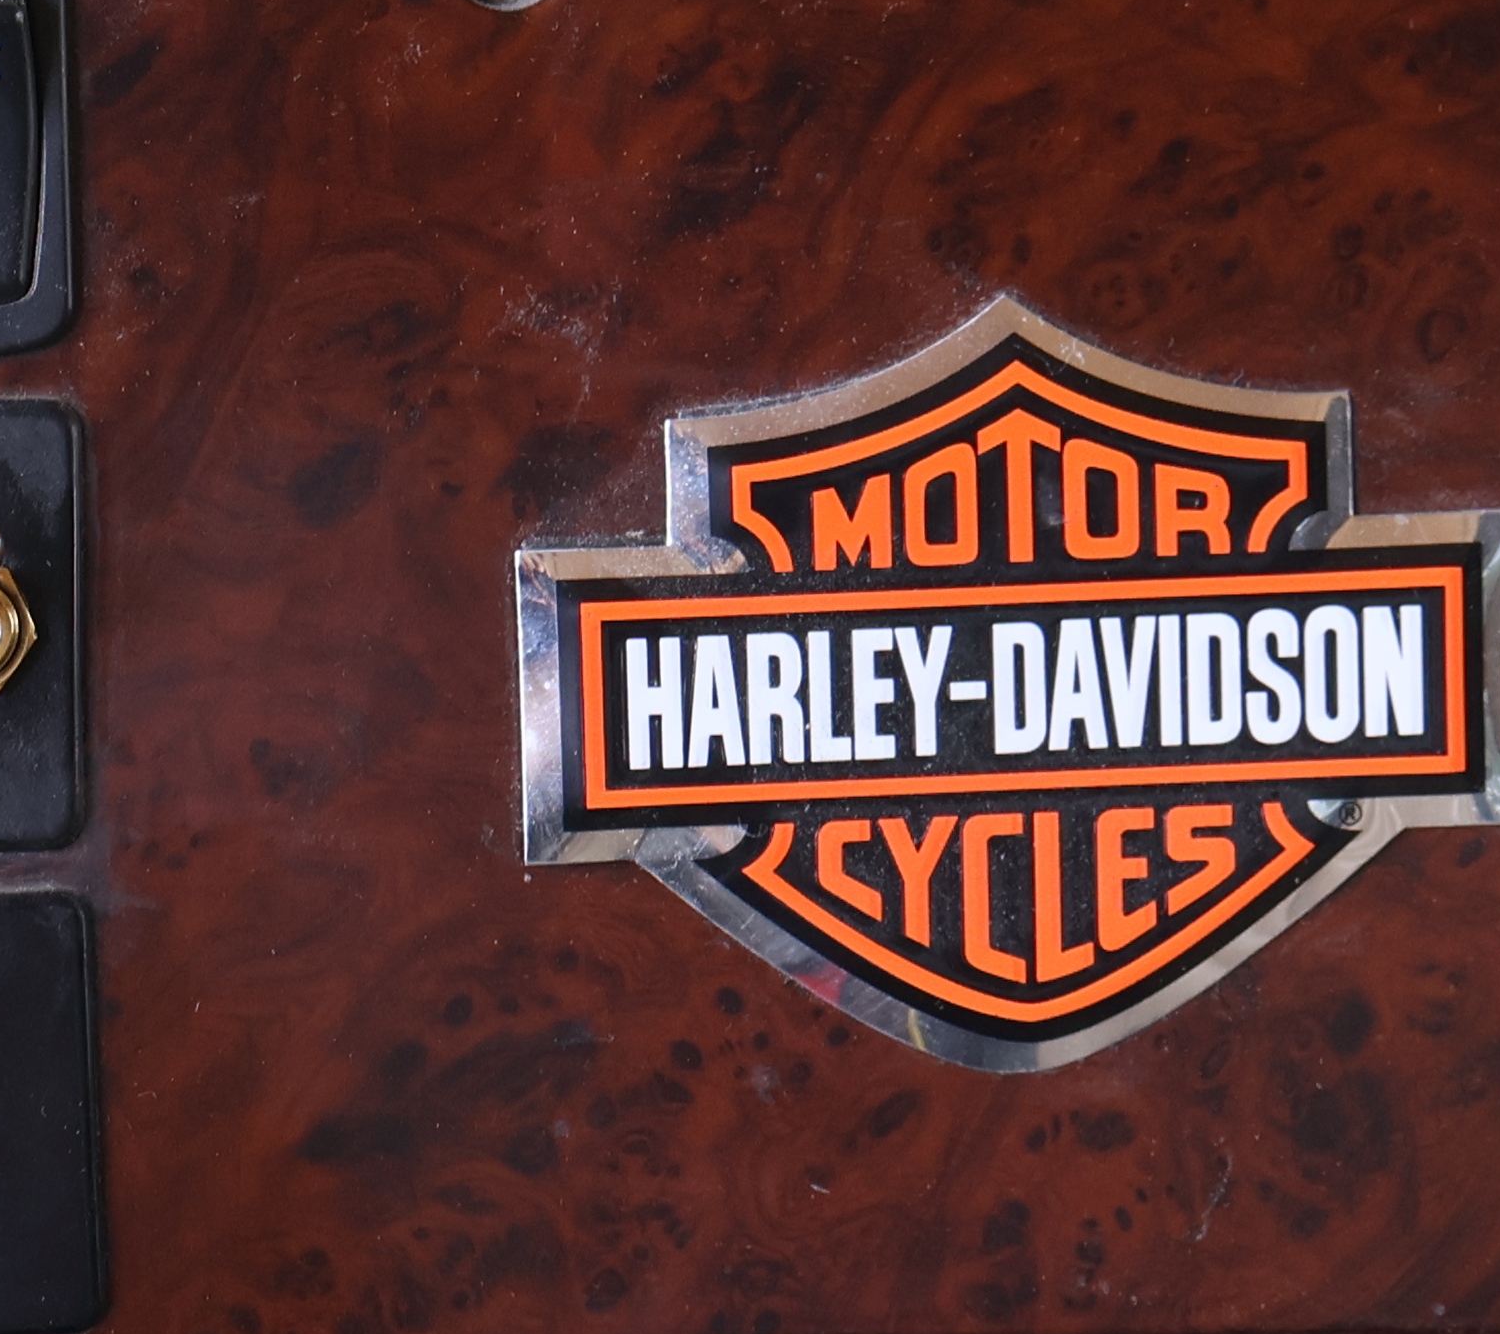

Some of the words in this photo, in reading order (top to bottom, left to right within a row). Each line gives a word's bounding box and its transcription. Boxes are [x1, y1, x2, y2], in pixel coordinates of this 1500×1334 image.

[811, 406, 1233, 572] MOTOR
[624, 603, 1426, 772] HARLEY-DAVIDSON
[816, 801, 1238, 985] CYCLES
